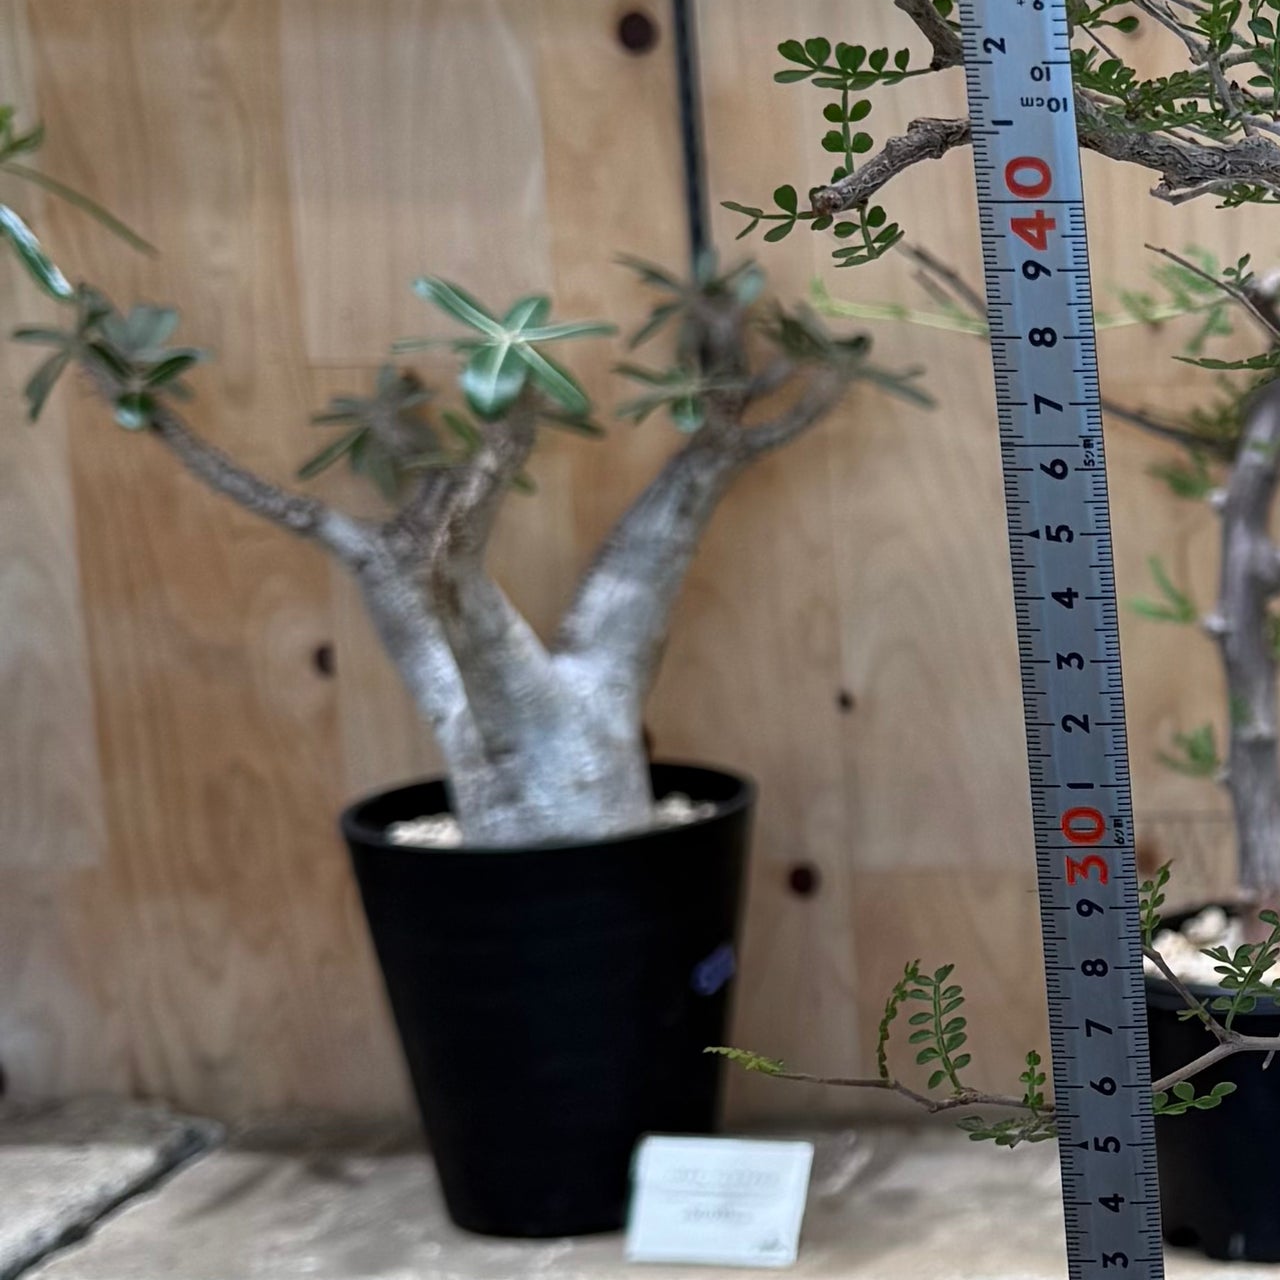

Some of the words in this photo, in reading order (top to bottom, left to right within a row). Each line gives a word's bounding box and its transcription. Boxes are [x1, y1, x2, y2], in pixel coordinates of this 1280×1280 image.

[983, 37, 1007, 54] 2
[1030, 66, 1051, 81] 10
[1020, 96, 1068, 113] 10cm
[1022, 260, 1051, 280] 9
[1029, 327, 1057, 347] 8
[1034, 393, 1064, 414] 7
[1039, 458, 1069, 480] 6
[1046, 524, 1074, 543] 5
[1051, 587, 1079, 609] 4
[1057, 652, 1084, 670] 3
[1061, 714, 1090, 734] 2
[1076, 899, 1104, 917] 9
[1081, 958, 1109, 977] 8
[1085, 1018, 1114, 1037] 7
[1089, 1076, 1117, 1096] 6
[1094, 1136, 1121, 1153] 5
[1099, 1193, 1125, 1212] 4
[1102, 1252, 1129, 1269] 3
